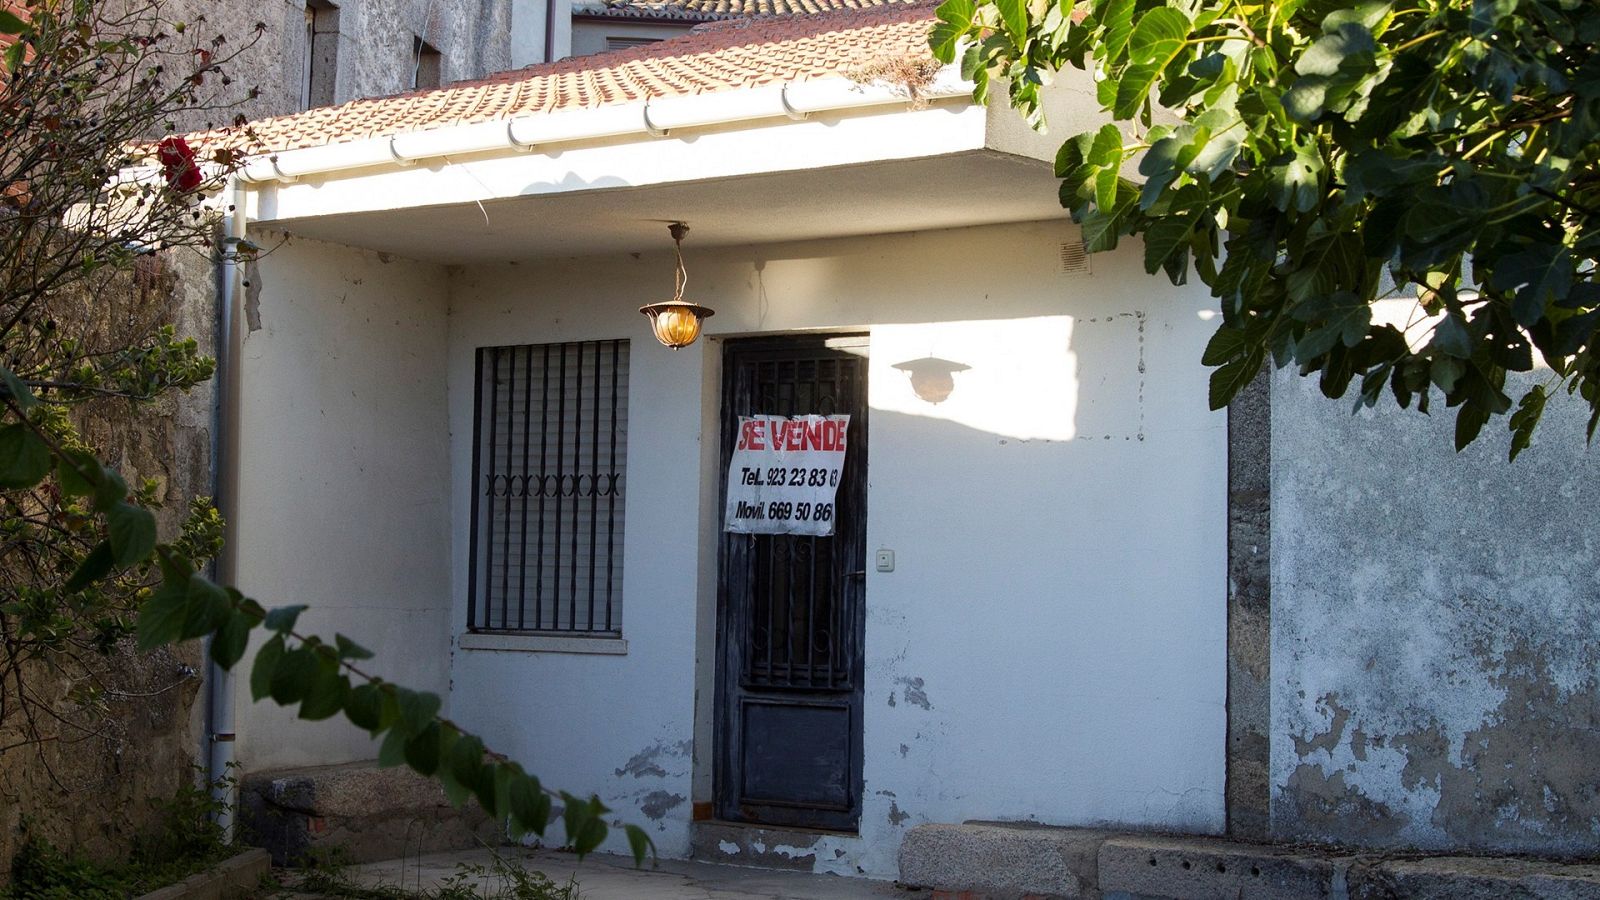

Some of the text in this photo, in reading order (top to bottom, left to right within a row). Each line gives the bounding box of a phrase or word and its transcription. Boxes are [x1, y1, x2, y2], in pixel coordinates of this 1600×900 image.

[738, 420, 847, 451] SE VENDE
[767, 467, 786, 486] 923
[788, 467, 806, 486] 23
[808, 468, 827, 487] 83
[768, 501, 792, 520] 669
[794, 502, 811, 521] 50
